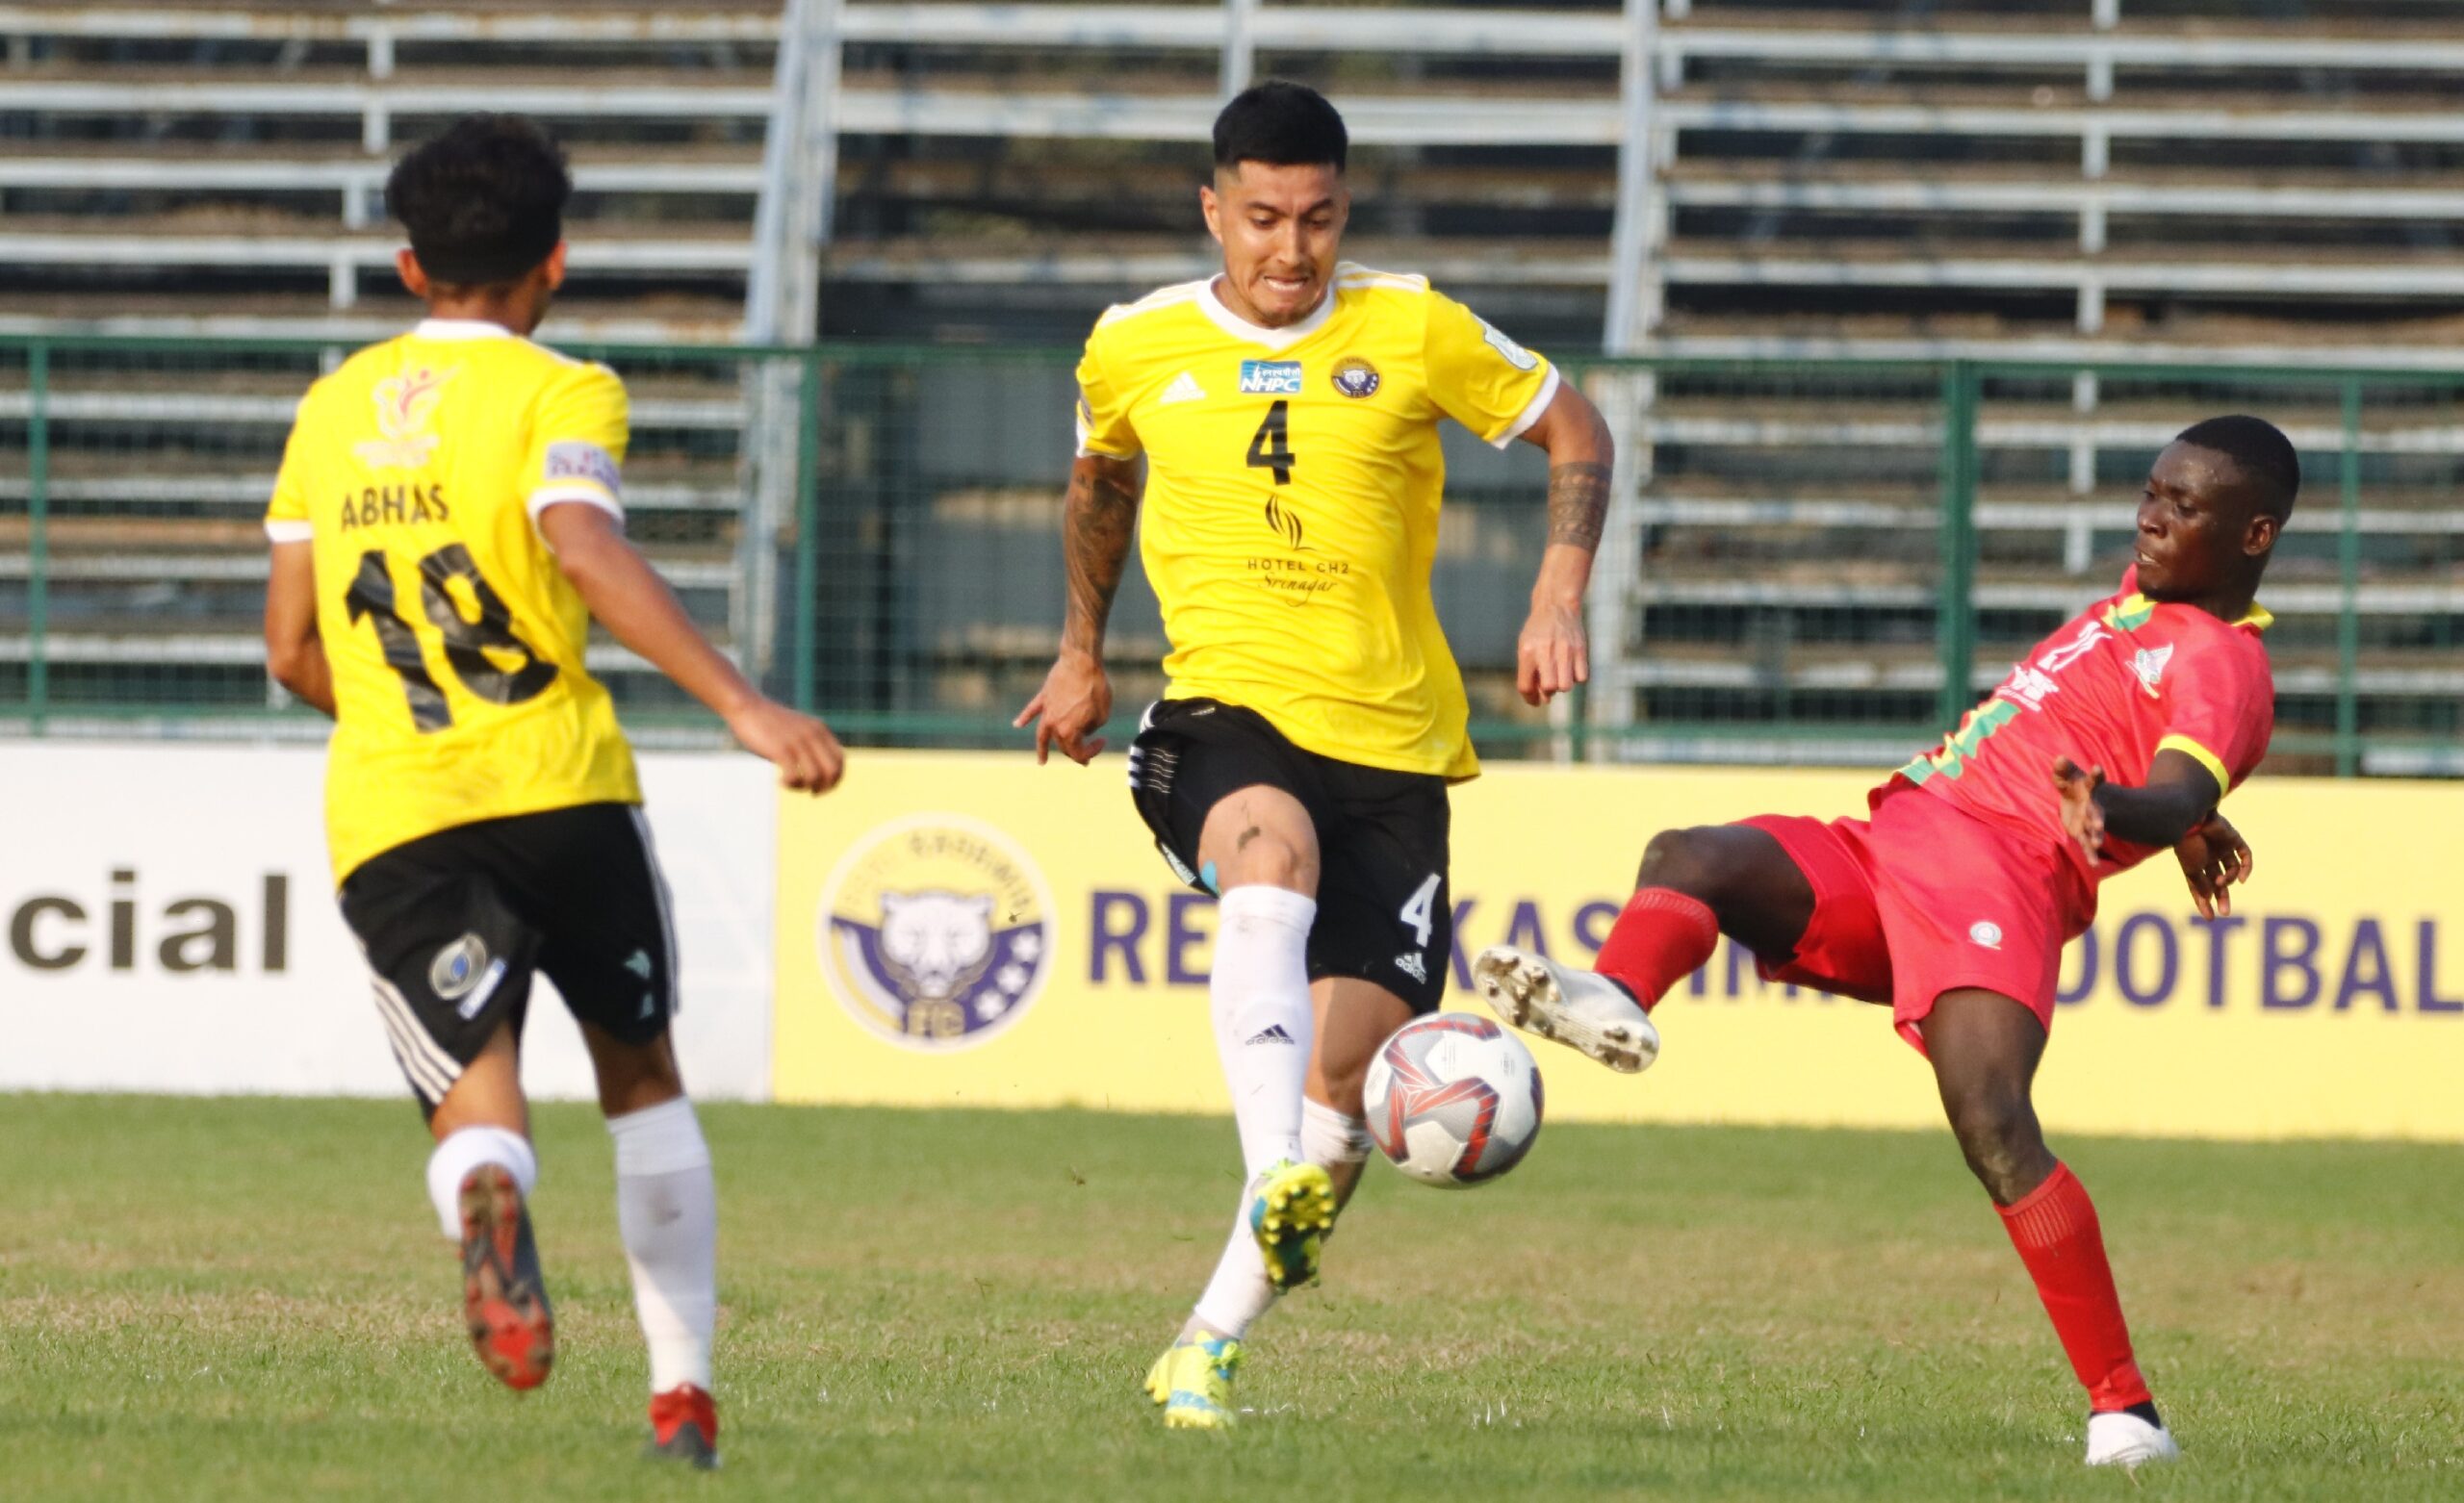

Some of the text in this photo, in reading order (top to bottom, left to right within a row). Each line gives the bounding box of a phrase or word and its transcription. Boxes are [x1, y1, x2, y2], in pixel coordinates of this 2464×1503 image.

[1241, 372, 1300, 392] NHPC
[1246, 400, 1296, 485] 4
[341, 483, 449, 531] ABHAS
[1247, 558, 1349, 574] HOTEL CH2
[345, 542, 560, 734] 18
[9, 869, 288, 972] cial
[1400, 872, 1442, 948] 4
